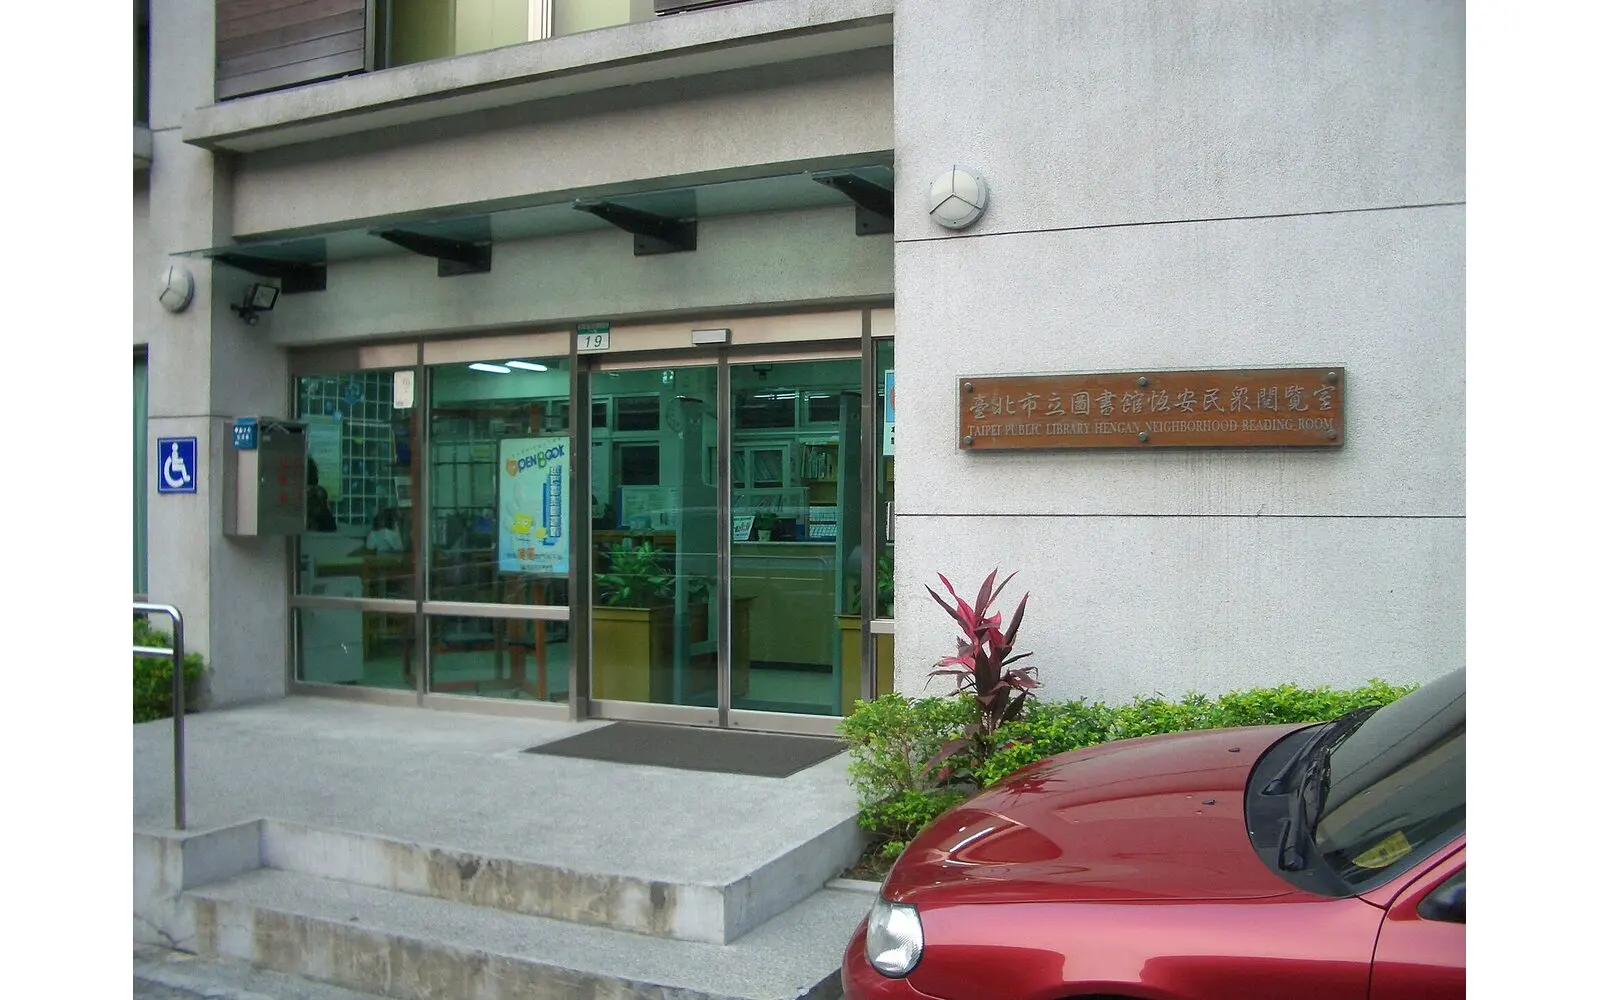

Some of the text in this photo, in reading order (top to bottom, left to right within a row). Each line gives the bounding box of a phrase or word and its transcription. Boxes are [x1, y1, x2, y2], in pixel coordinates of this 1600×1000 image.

[585, 334, 602, 348] 19
[967, 417, 1334, 437] TAIPEI PUBLIC LIBRARY HENGAN NEIGHBORHOOD READING ROOM
